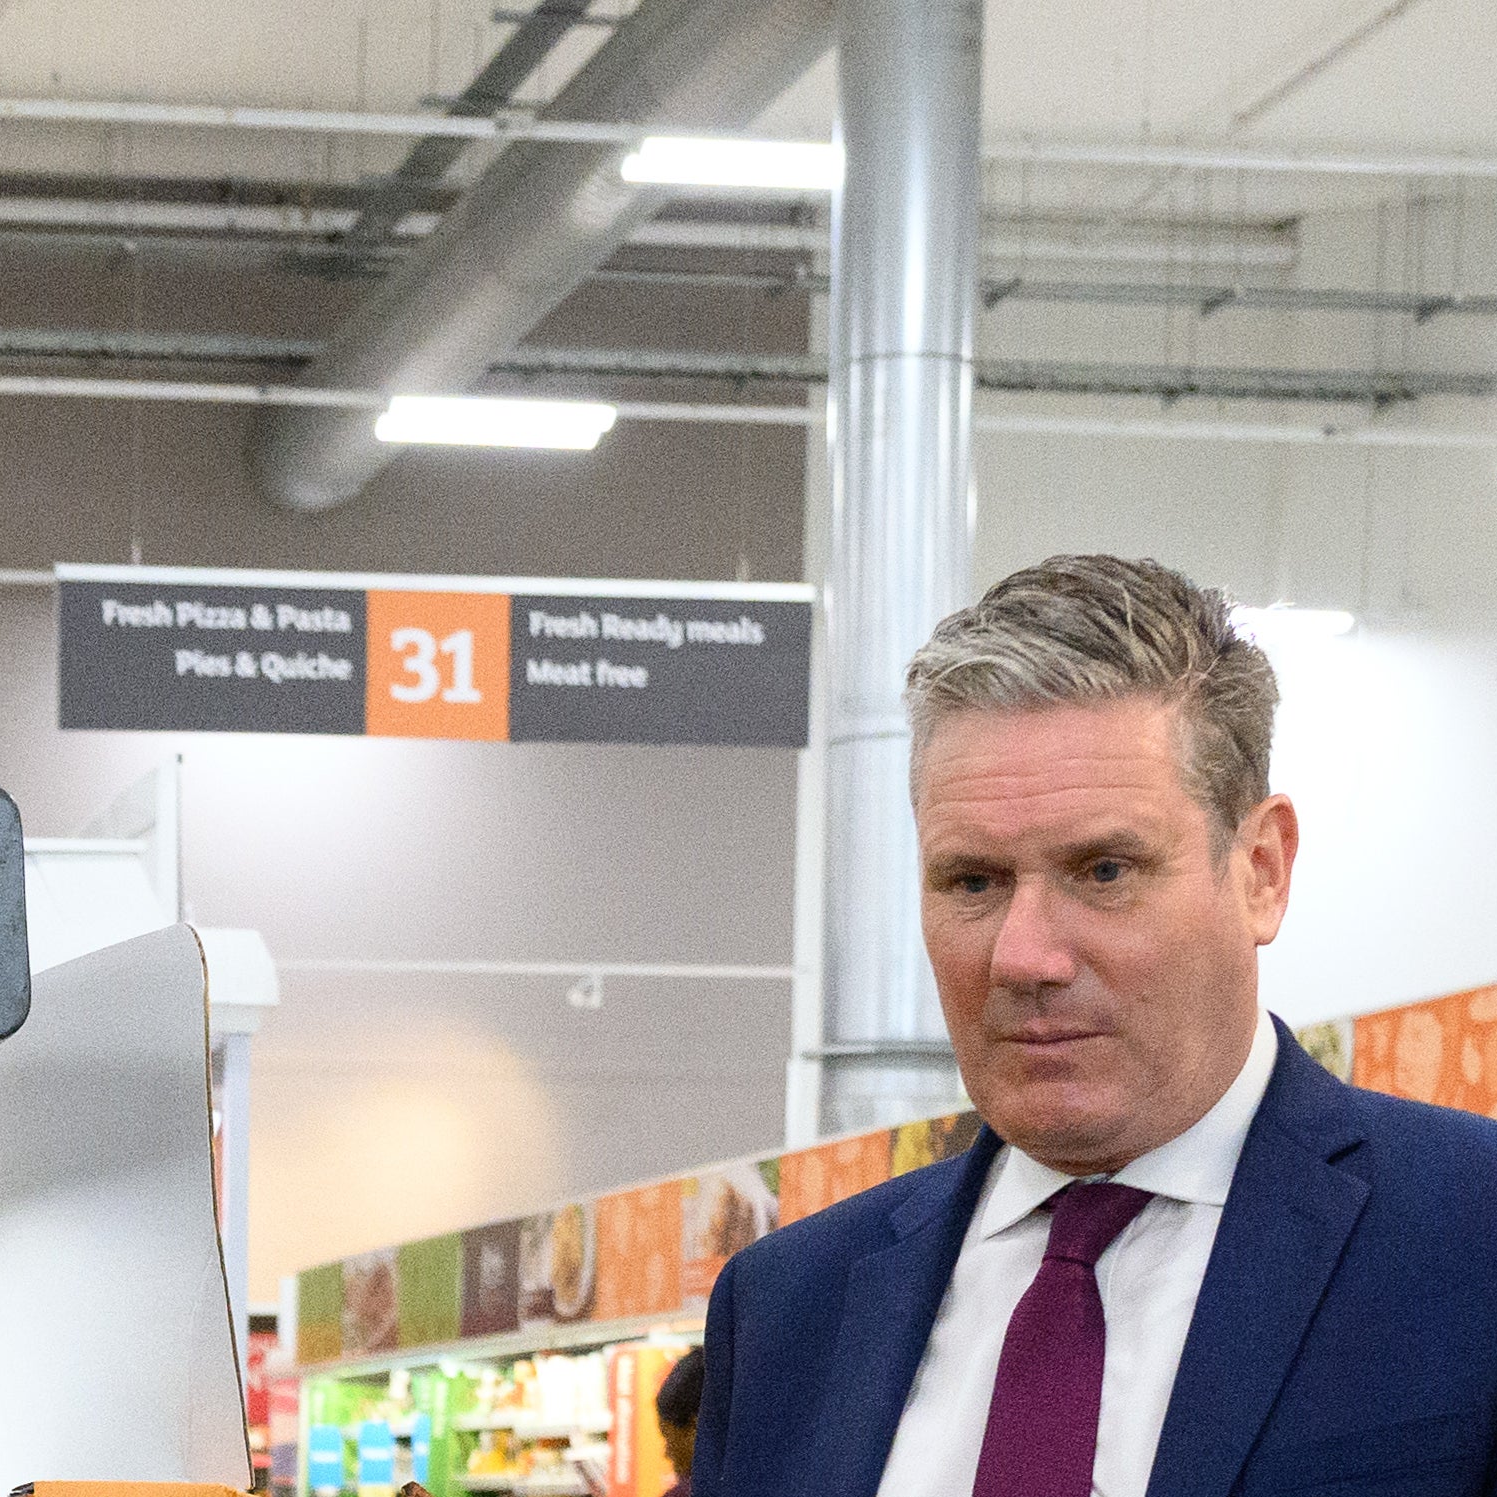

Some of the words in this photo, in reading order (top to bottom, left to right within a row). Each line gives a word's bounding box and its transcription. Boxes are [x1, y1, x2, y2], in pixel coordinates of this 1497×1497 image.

[103, 600, 173, 627] Fresh
[176, 602, 246, 629] Pizza
[250, 604, 273, 631] &
[275, 604, 352, 633] Pasta
[529, 611, 599, 638] Fresh
[601, 614, 684, 648] Ready
[685, 616, 765, 645] meals
[176, 651, 232, 677] Pies
[234, 651, 257, 679] &
[260, 652, 352, 683] Quiche
[390, 628, 481, 703] 31
[526, 659, 591, 686] Meat
